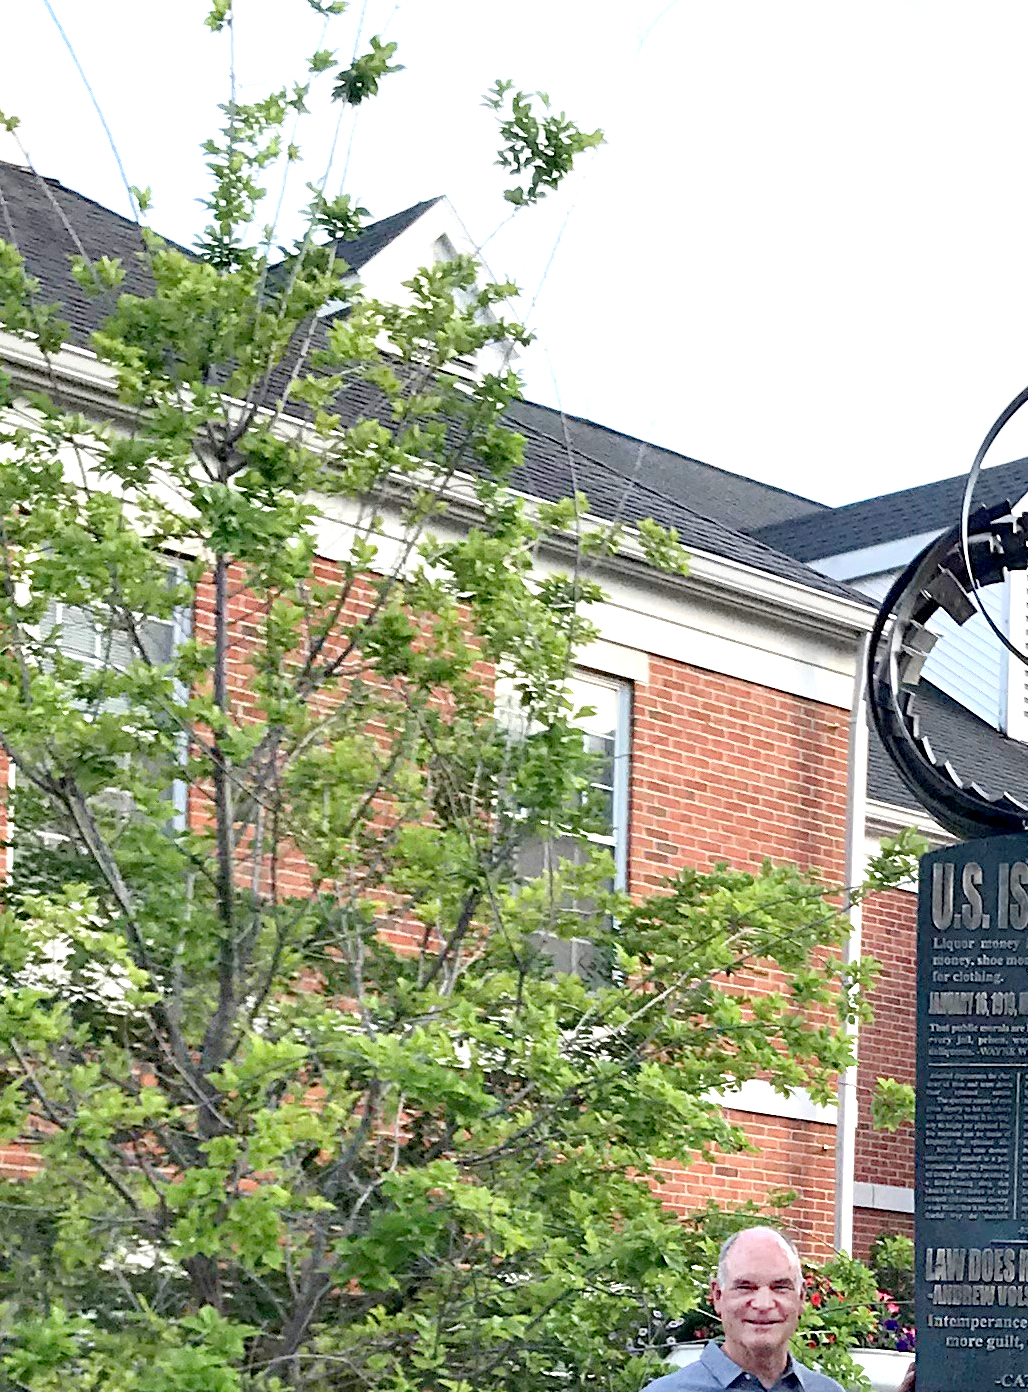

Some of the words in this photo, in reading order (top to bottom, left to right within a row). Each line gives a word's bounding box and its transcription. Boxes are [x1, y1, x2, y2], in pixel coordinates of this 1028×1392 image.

[932, 862, 990, 930] U.S.
[933, 937, 975, 952] Liquor
[980, 940, 1019, 952] money
[977, 954, 1003, 966] shoe
[932, 971, 950, 982] for
[952, 971, 1004, 984] clothing.
[925, 1248, 966, 1282] LAW
[968, 1248, 1015, 1283] DOES
[927, 1284, 995, 1306] -ANDREW
[927, 1314, 1028, 1331] Intemperance
[946, 1336, 983, 1348] more
[986, 1335, 1025, 1351] guilt,
